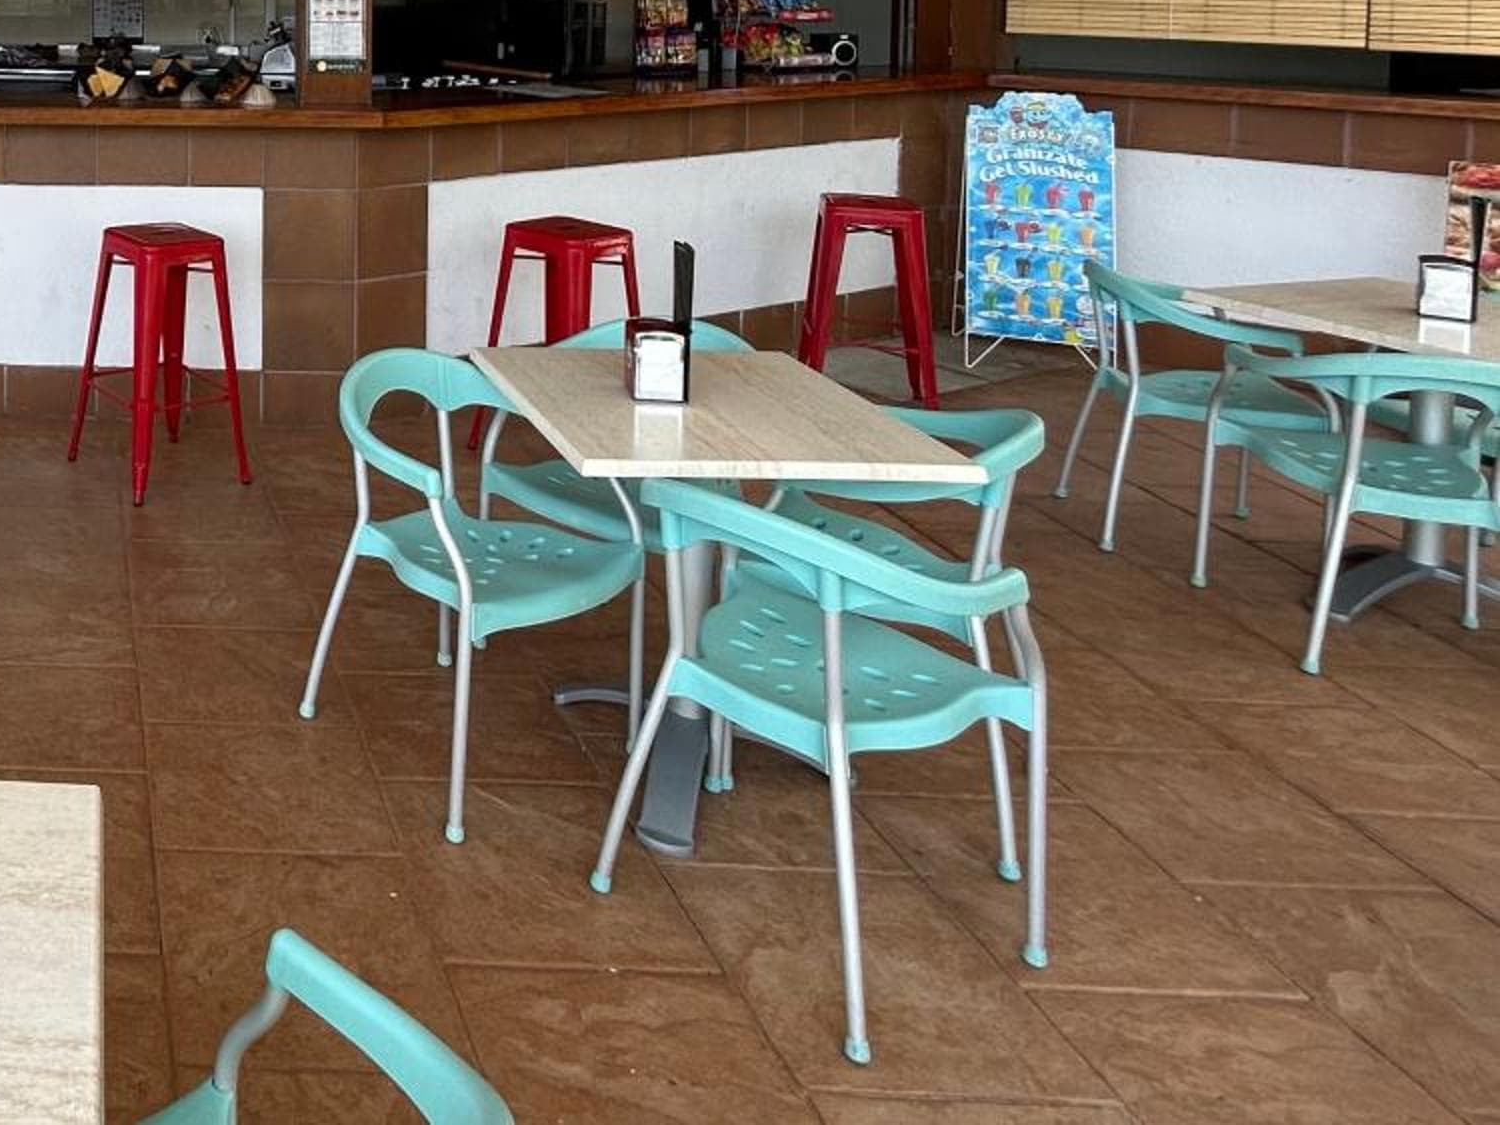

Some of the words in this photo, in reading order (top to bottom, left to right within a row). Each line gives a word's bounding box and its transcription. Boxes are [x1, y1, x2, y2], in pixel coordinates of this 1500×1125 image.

[986, 146, 1089, 170] Granizate
[979, 161, 1016, 183] Get
[1017, 160, 1100, 184] Slushed
